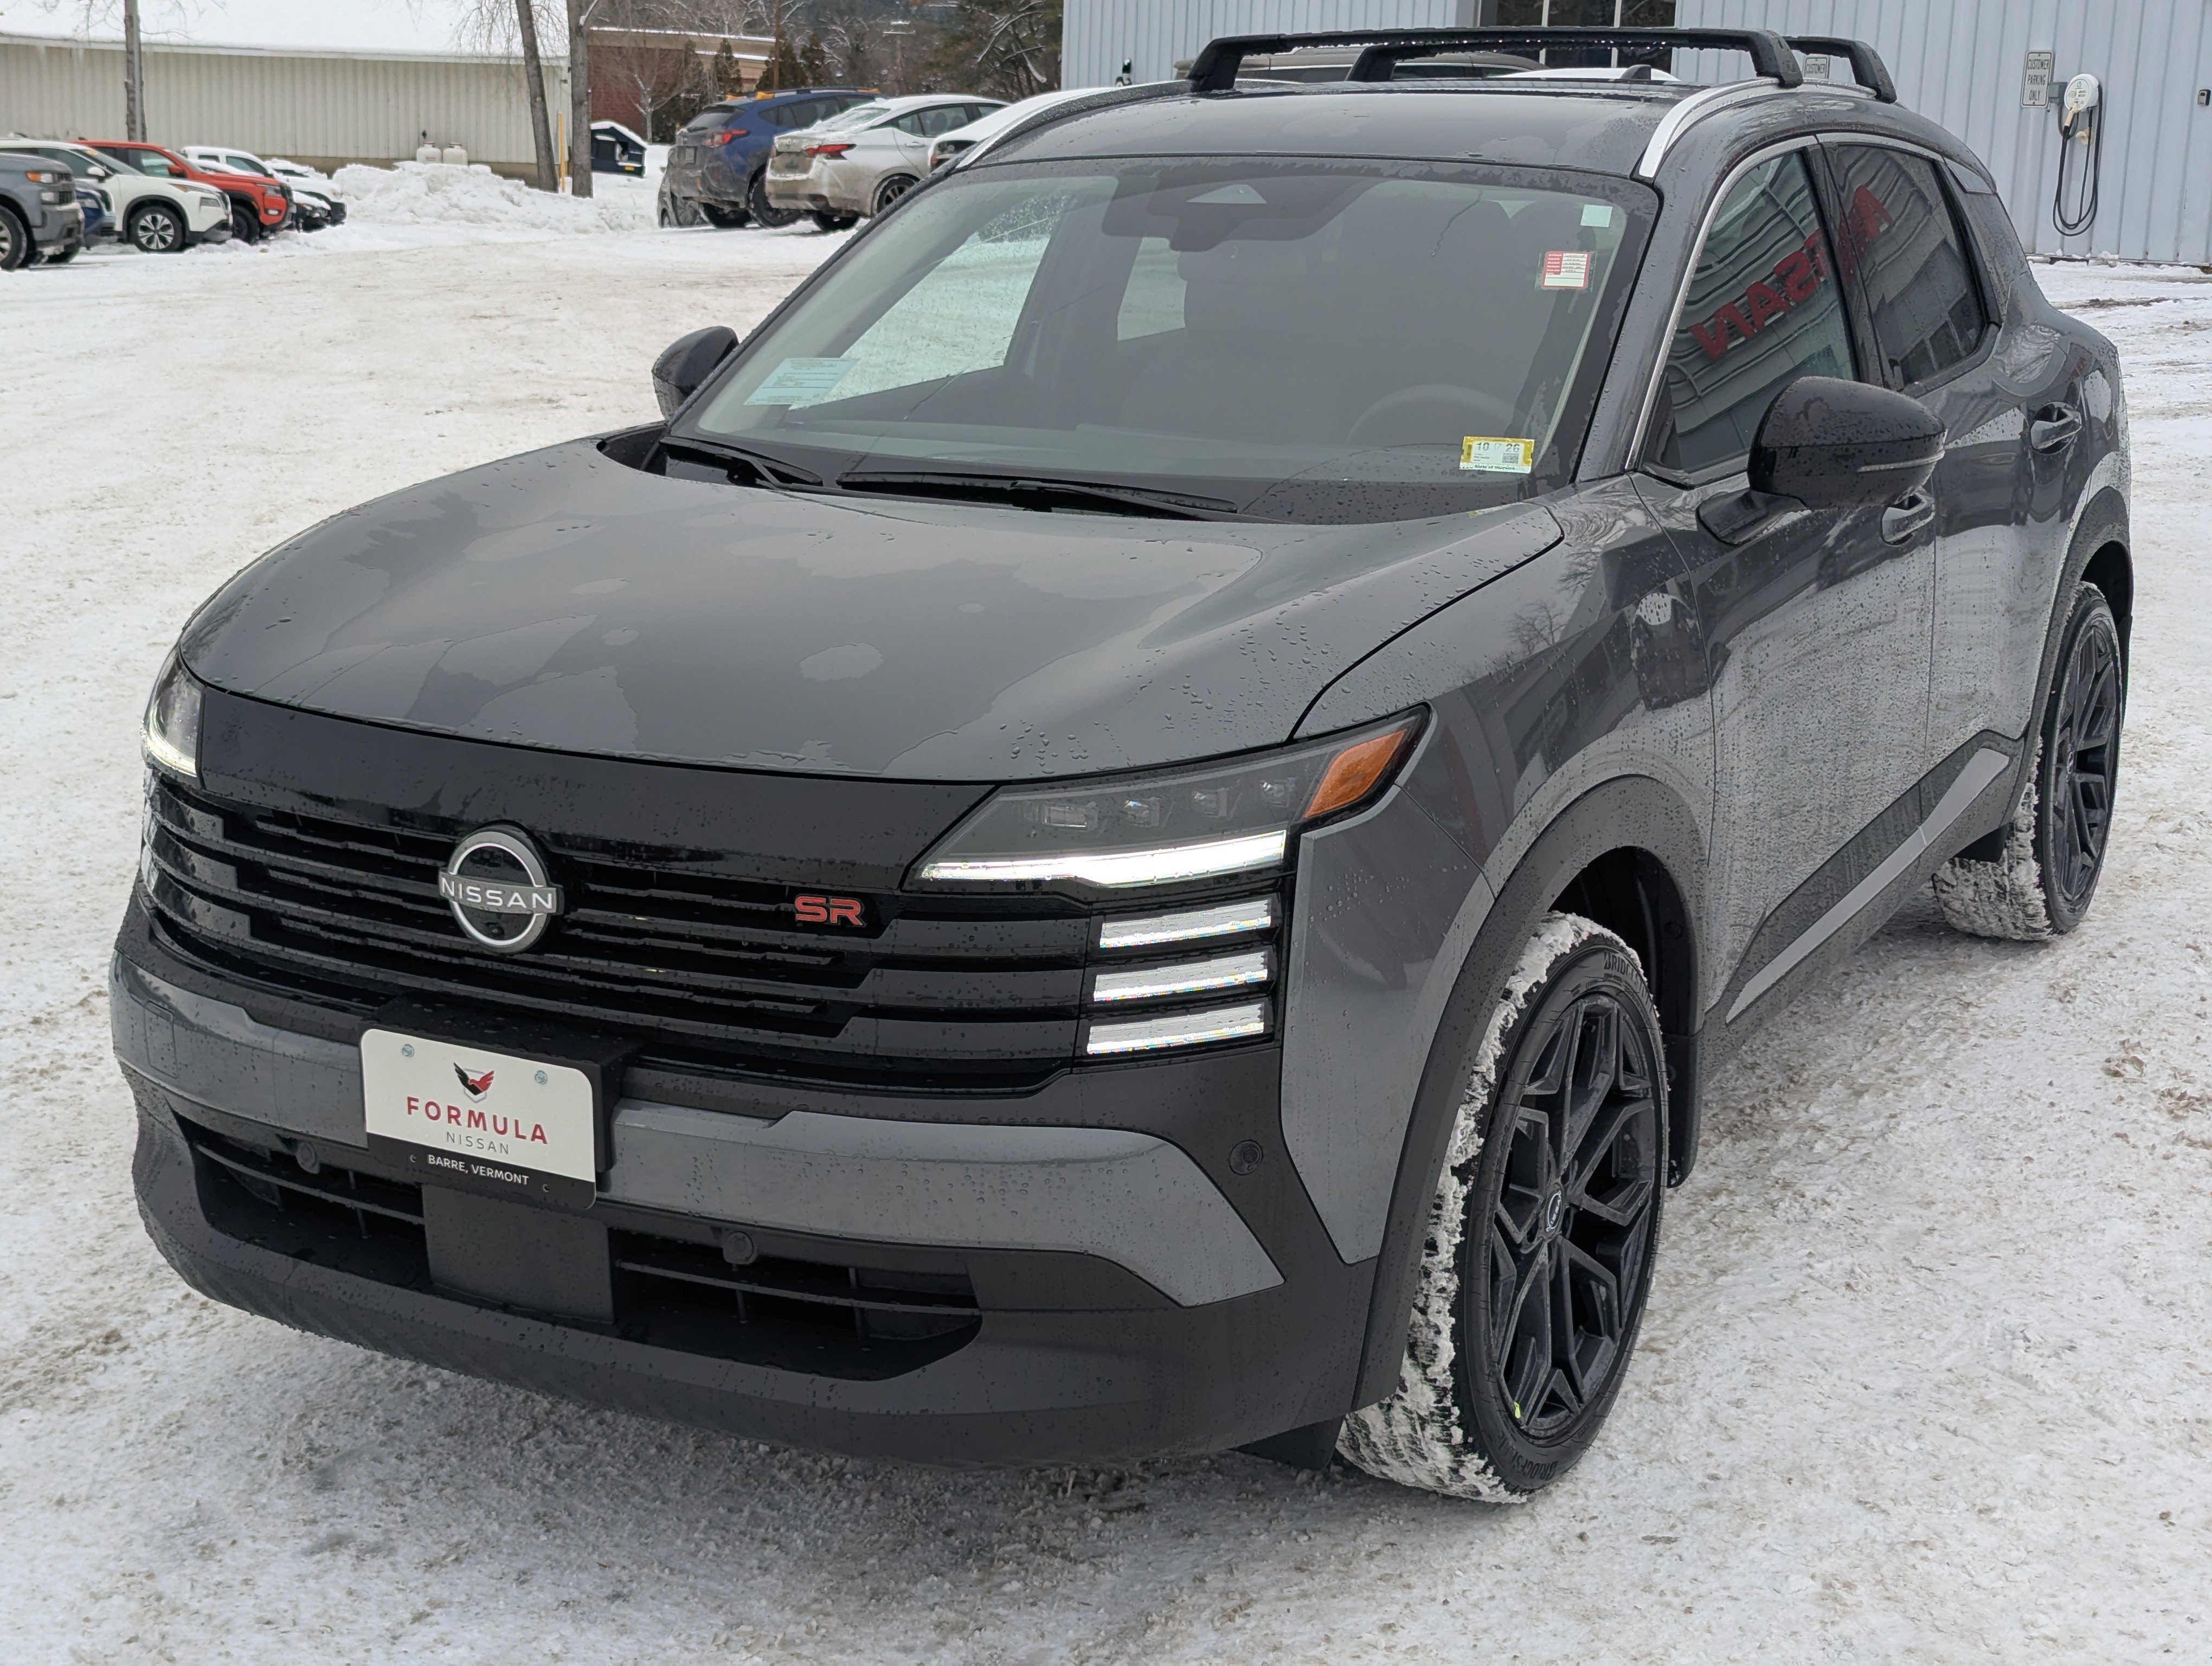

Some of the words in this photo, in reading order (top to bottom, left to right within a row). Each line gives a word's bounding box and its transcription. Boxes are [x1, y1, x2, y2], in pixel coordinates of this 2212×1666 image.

[2027, 59, 2050, 70] CUSTOMER
[2027, 74, 2046, 85] PARKING
[2029, 89, 2041, 101] ONLY
[1476, 442, 1490, 451] 10
[441, 877, 552, 909] NISSAN
[795, 895, 863, 926] SR
[406, 1095, 549, 1145] FORMULA
[446, 1131, 510, 1155] NISSAN
[427, 1154, 469, 1174] BARRE,
[471, 1164, 530, 1186] VERMONT
